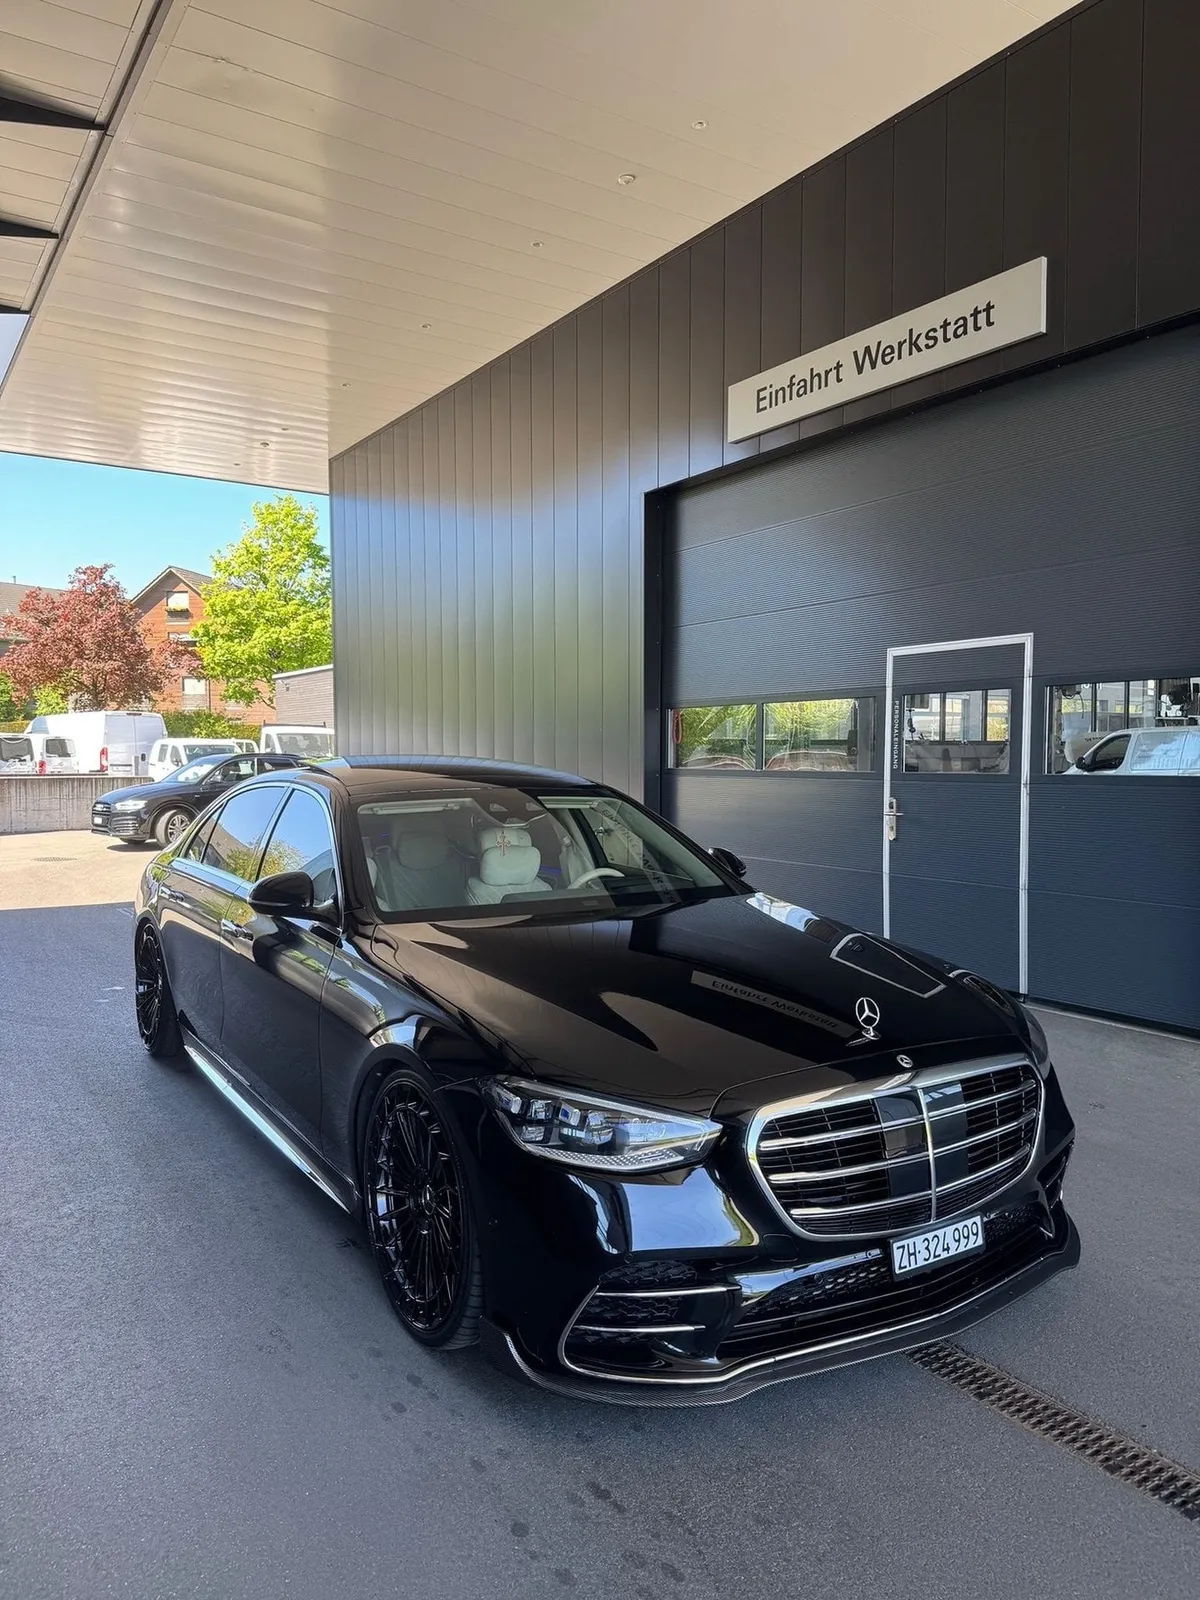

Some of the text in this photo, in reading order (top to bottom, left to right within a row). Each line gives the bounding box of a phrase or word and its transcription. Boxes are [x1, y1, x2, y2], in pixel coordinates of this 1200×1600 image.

[756, 300, 995, 414] Einfahrt Werkstatt
[892, 700, 900, 770] PERSONALEINGANG
